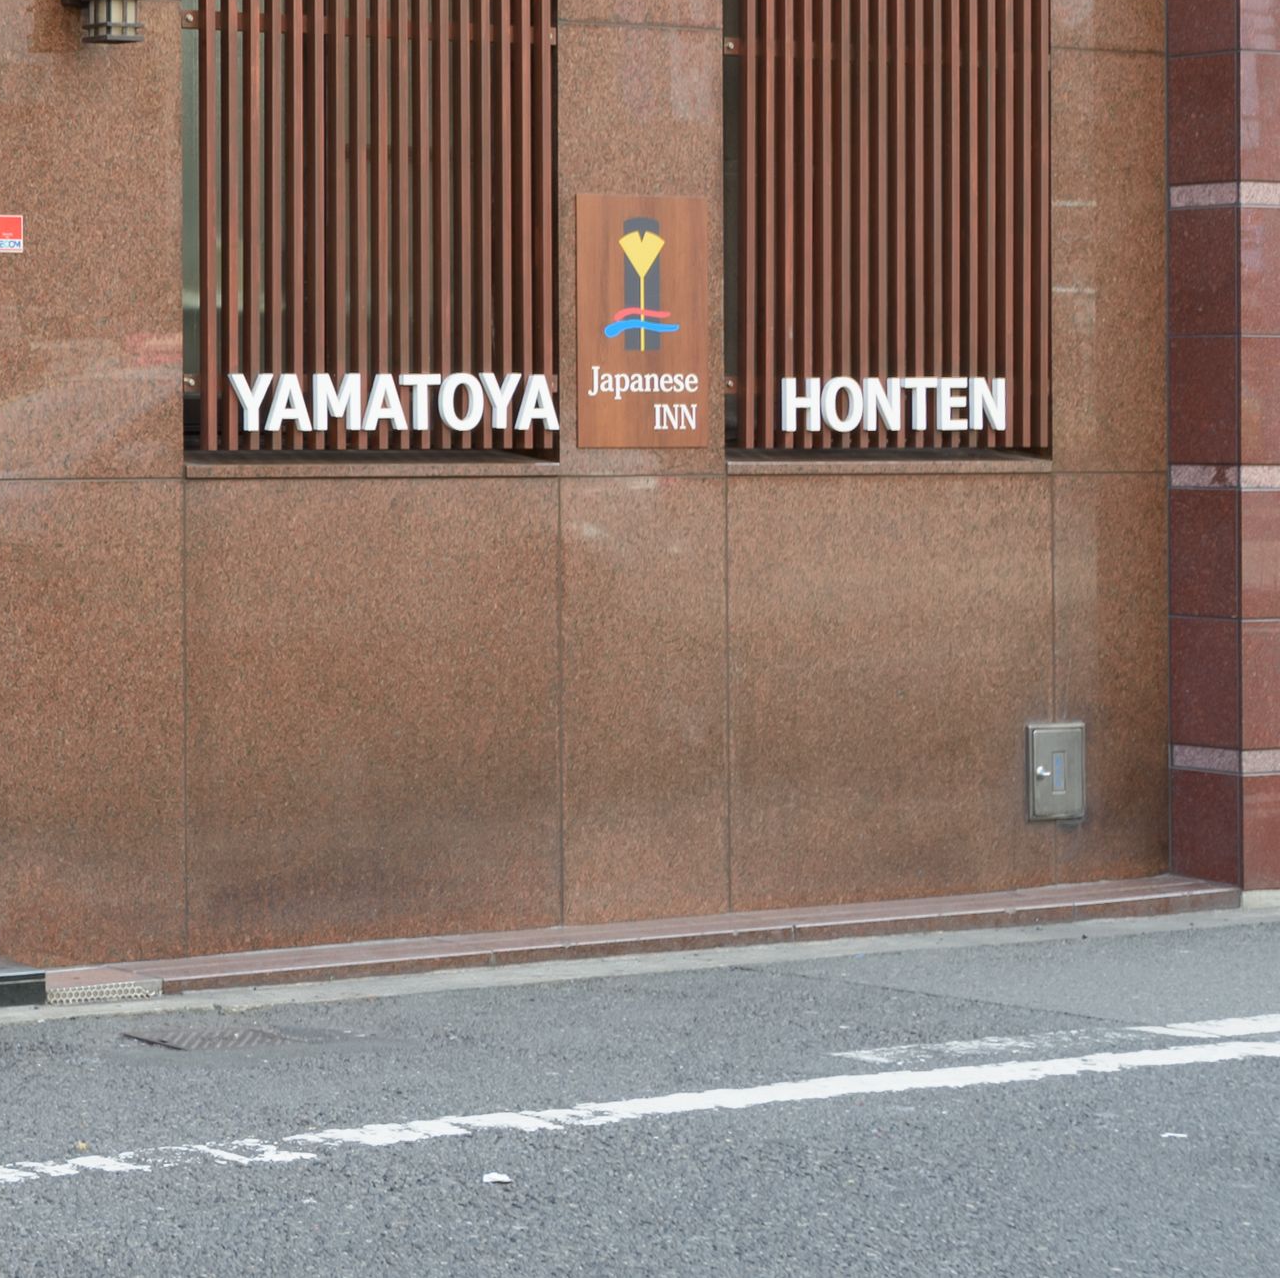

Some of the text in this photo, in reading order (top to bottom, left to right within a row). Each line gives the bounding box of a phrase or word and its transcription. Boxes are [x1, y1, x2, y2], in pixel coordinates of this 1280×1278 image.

[229, 372, 560, 432] YAMATOYA
[588, 365, 699, 400] Japanese
[782, 377, 1006, 432] HONTEN
[653, 403, 697, 430] INN
